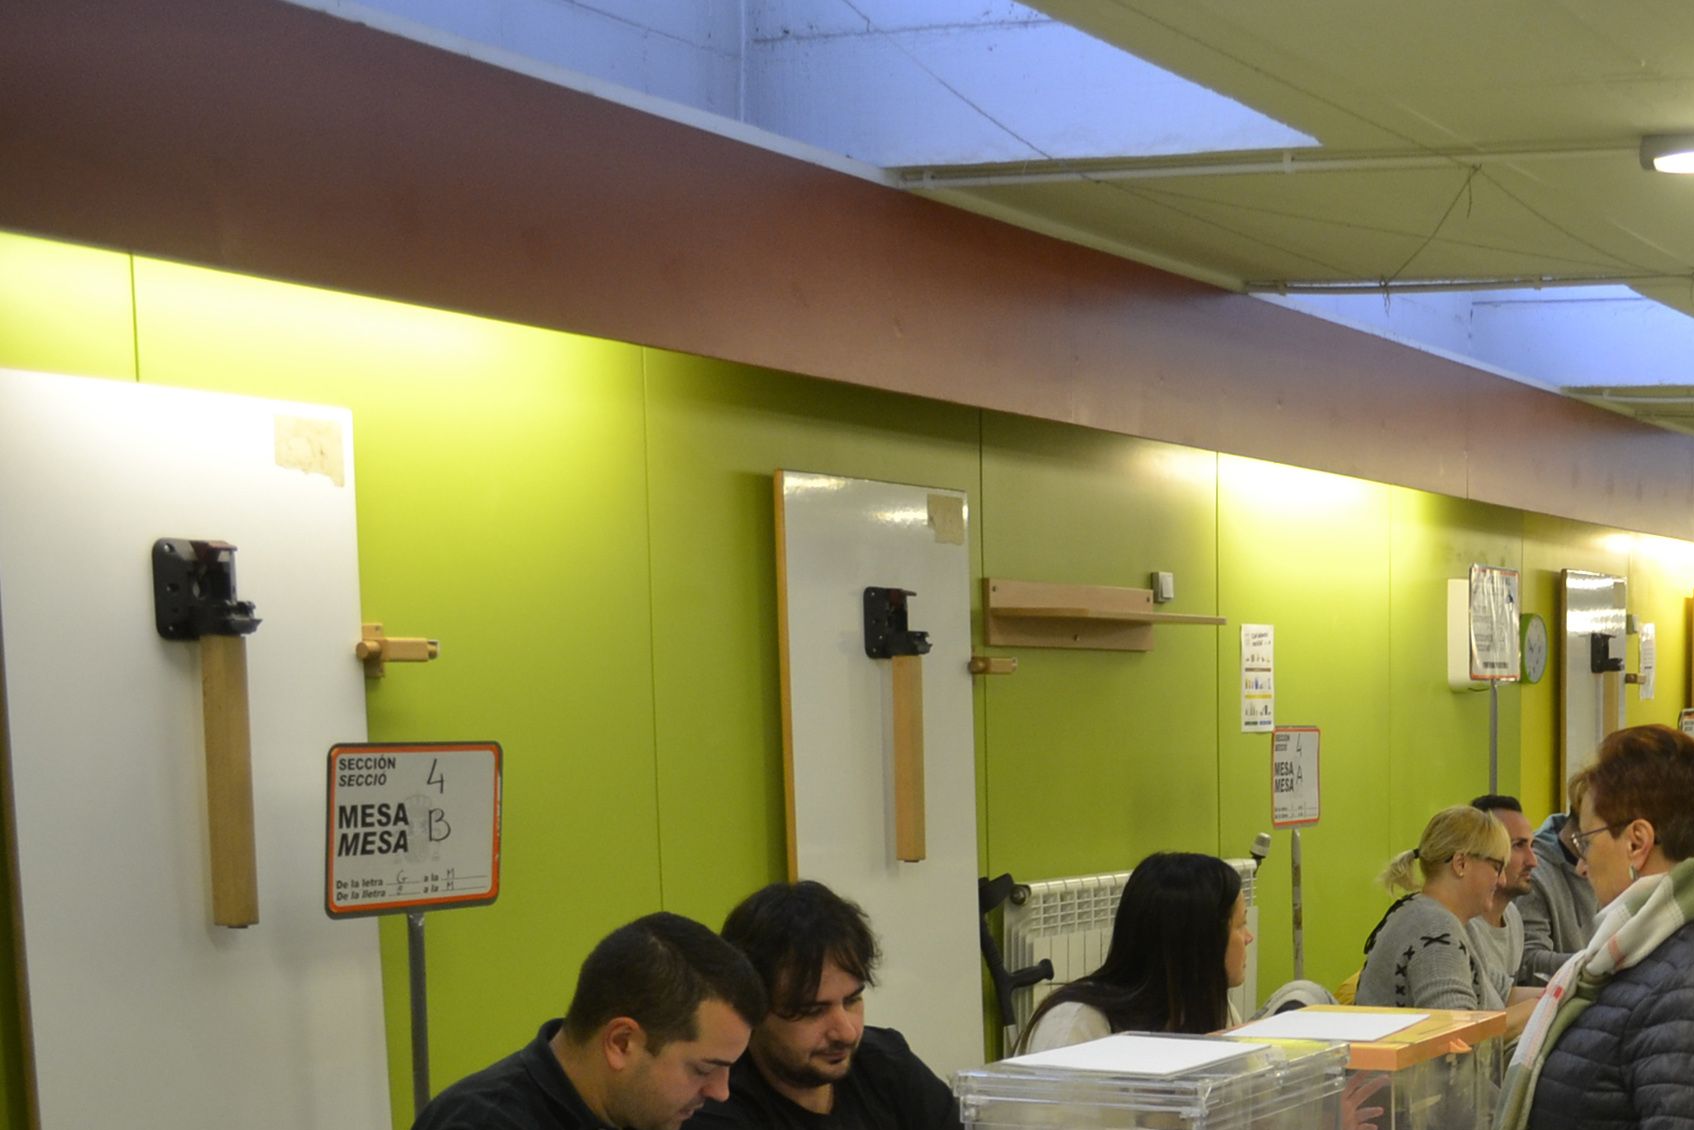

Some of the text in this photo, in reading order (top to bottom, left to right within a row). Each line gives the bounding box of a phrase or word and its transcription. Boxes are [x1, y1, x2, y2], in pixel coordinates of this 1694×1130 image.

[338, 755, 396, 771] SECCIÓN
[338, 773, 387, 787] SECCIÓ
[426, 758, 444, 794] 4
[338, 803, 409, 829] MESA
[428, 808, 451, 842] B
[337, 830, 409, 857] MESA
[336, 880, 348, 889] De
[351, 879, 359, 888] la
[362, 878, 383, 887] letra
[336, 892, 348, 901] De
[351, 891, 359, 900] la
